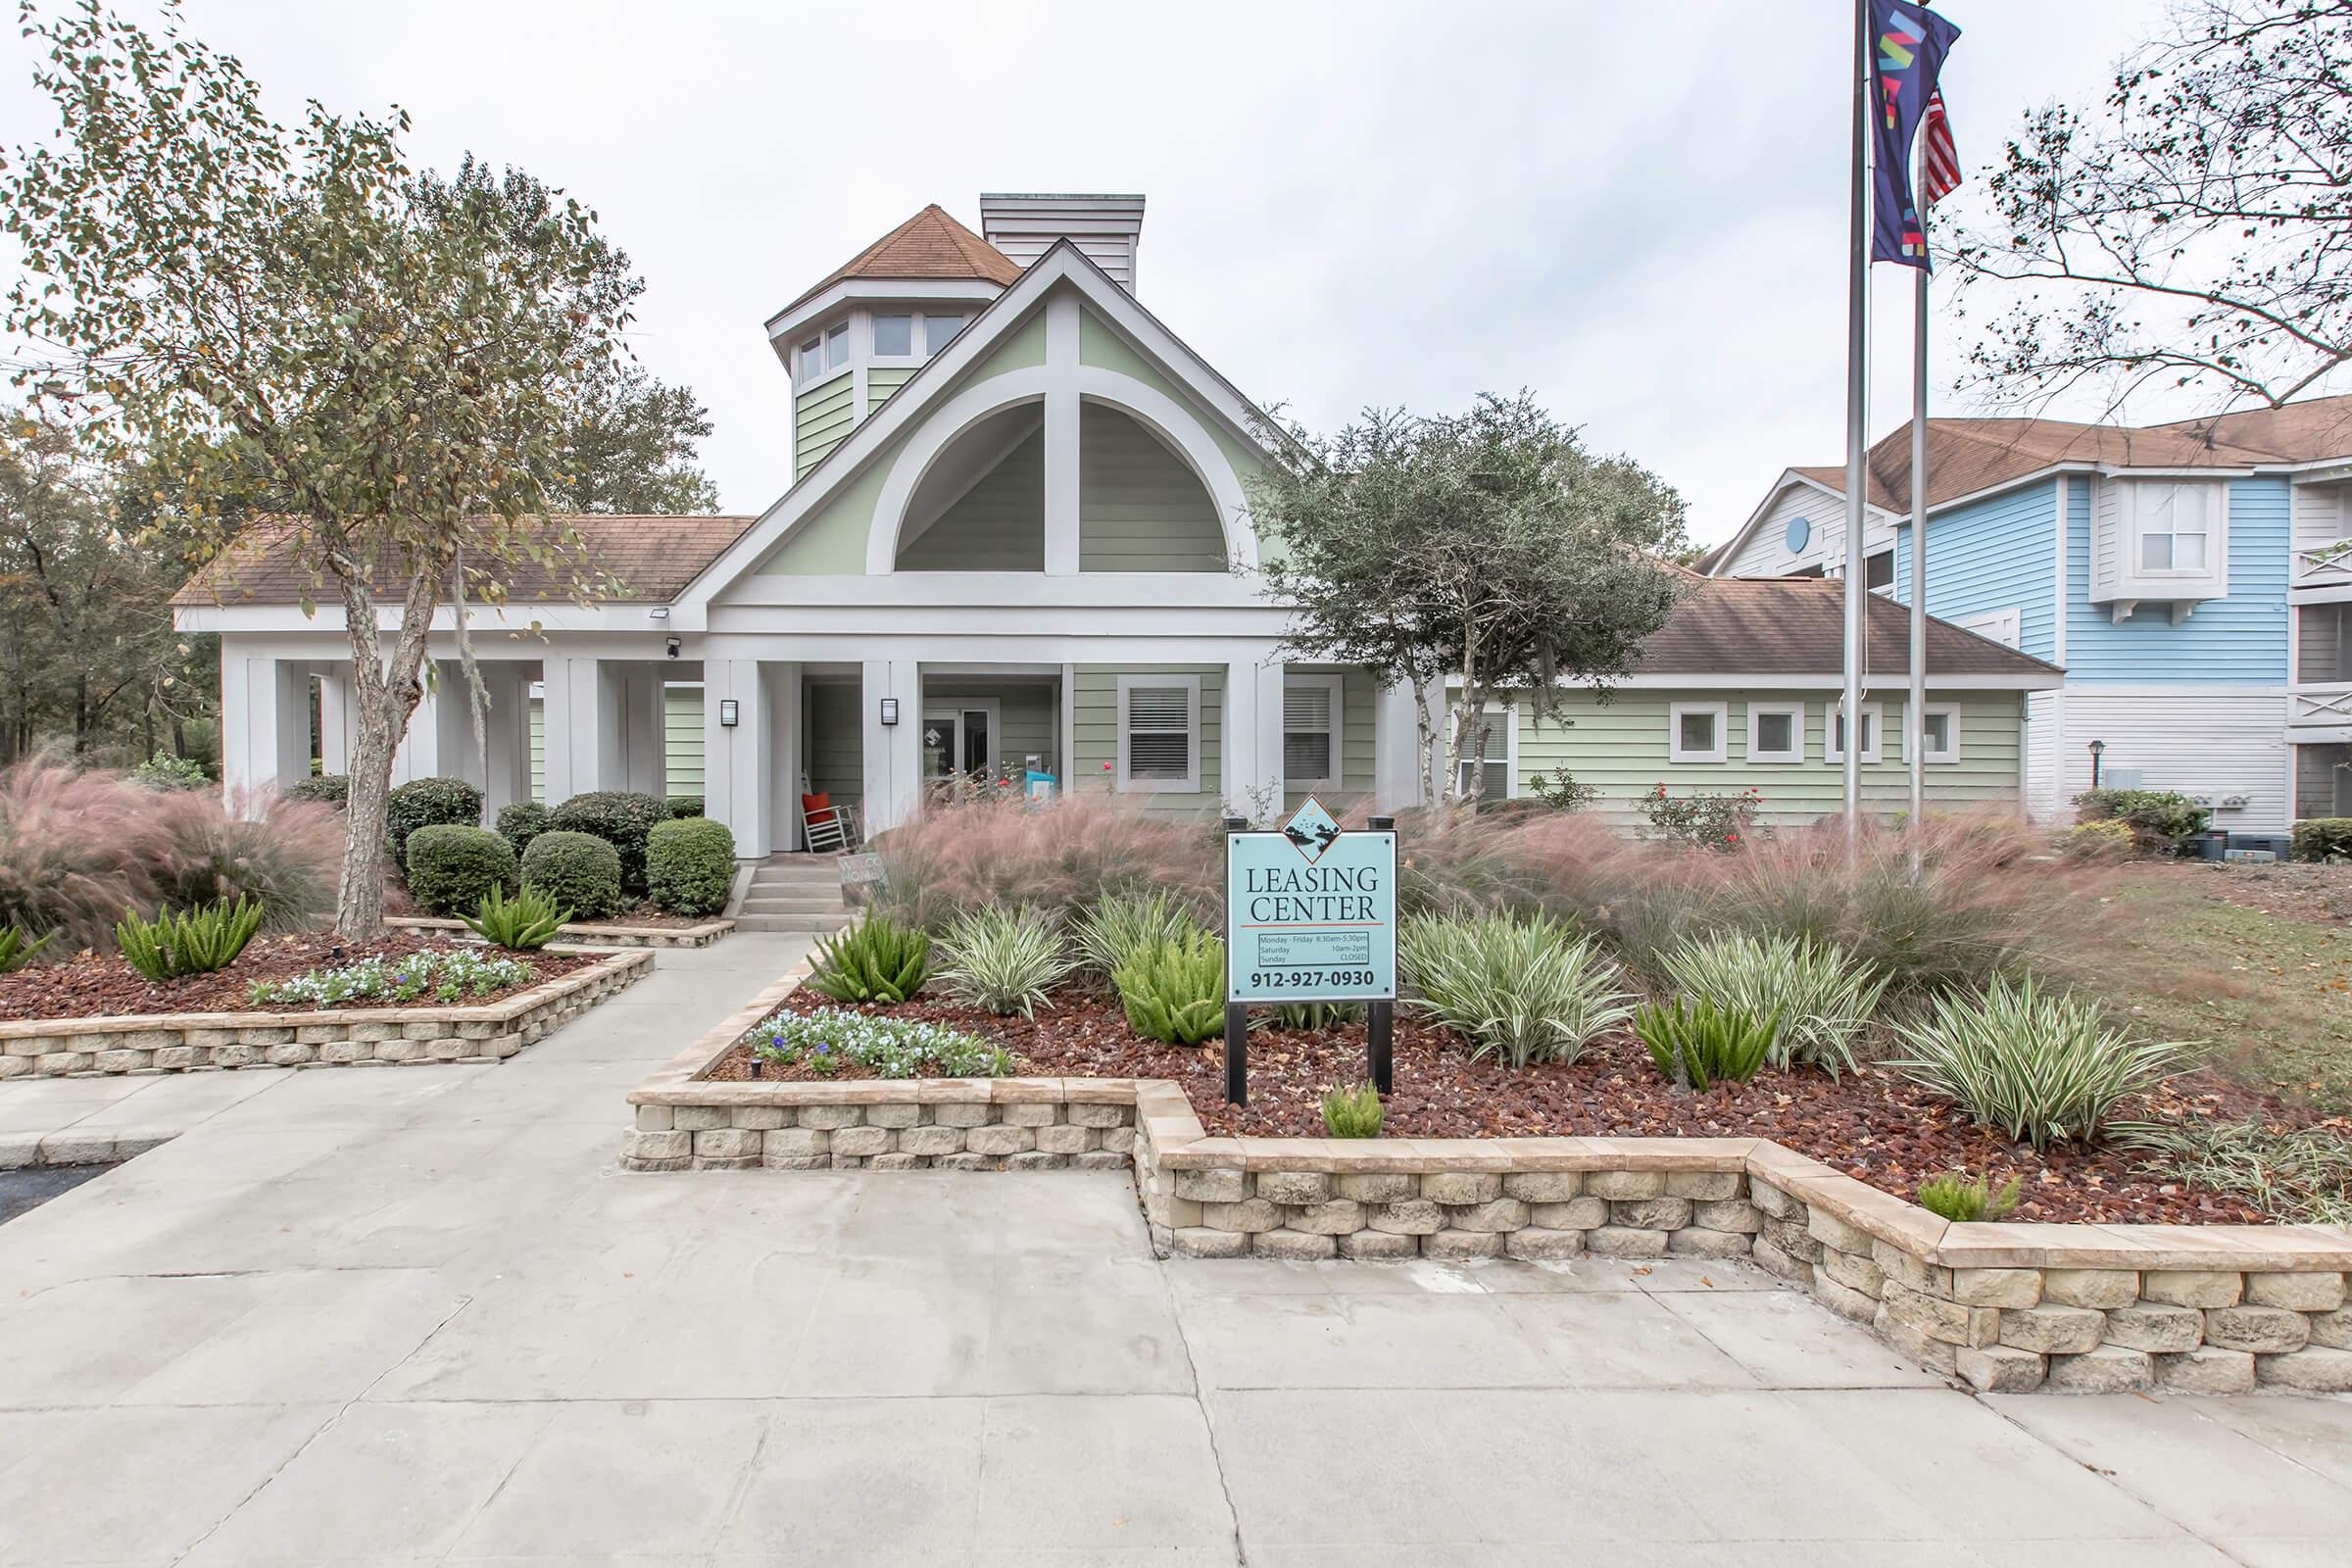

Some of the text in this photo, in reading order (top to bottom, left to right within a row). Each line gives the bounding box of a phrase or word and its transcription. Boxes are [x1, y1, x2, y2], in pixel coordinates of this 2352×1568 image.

[1246, 866, 1379, 893] LEASING
[1250, 896, 1376, 922] CENTER
[1260, 936, 1288, 946] Monday
[1293, 936, 1313, 945] Friday
[1260, 945, 1367, 956] Saturday 10am-2pm
[1260, 956, 1287, 964] Sunday
[1251, 971, 1374, 987] 912-927-0930
